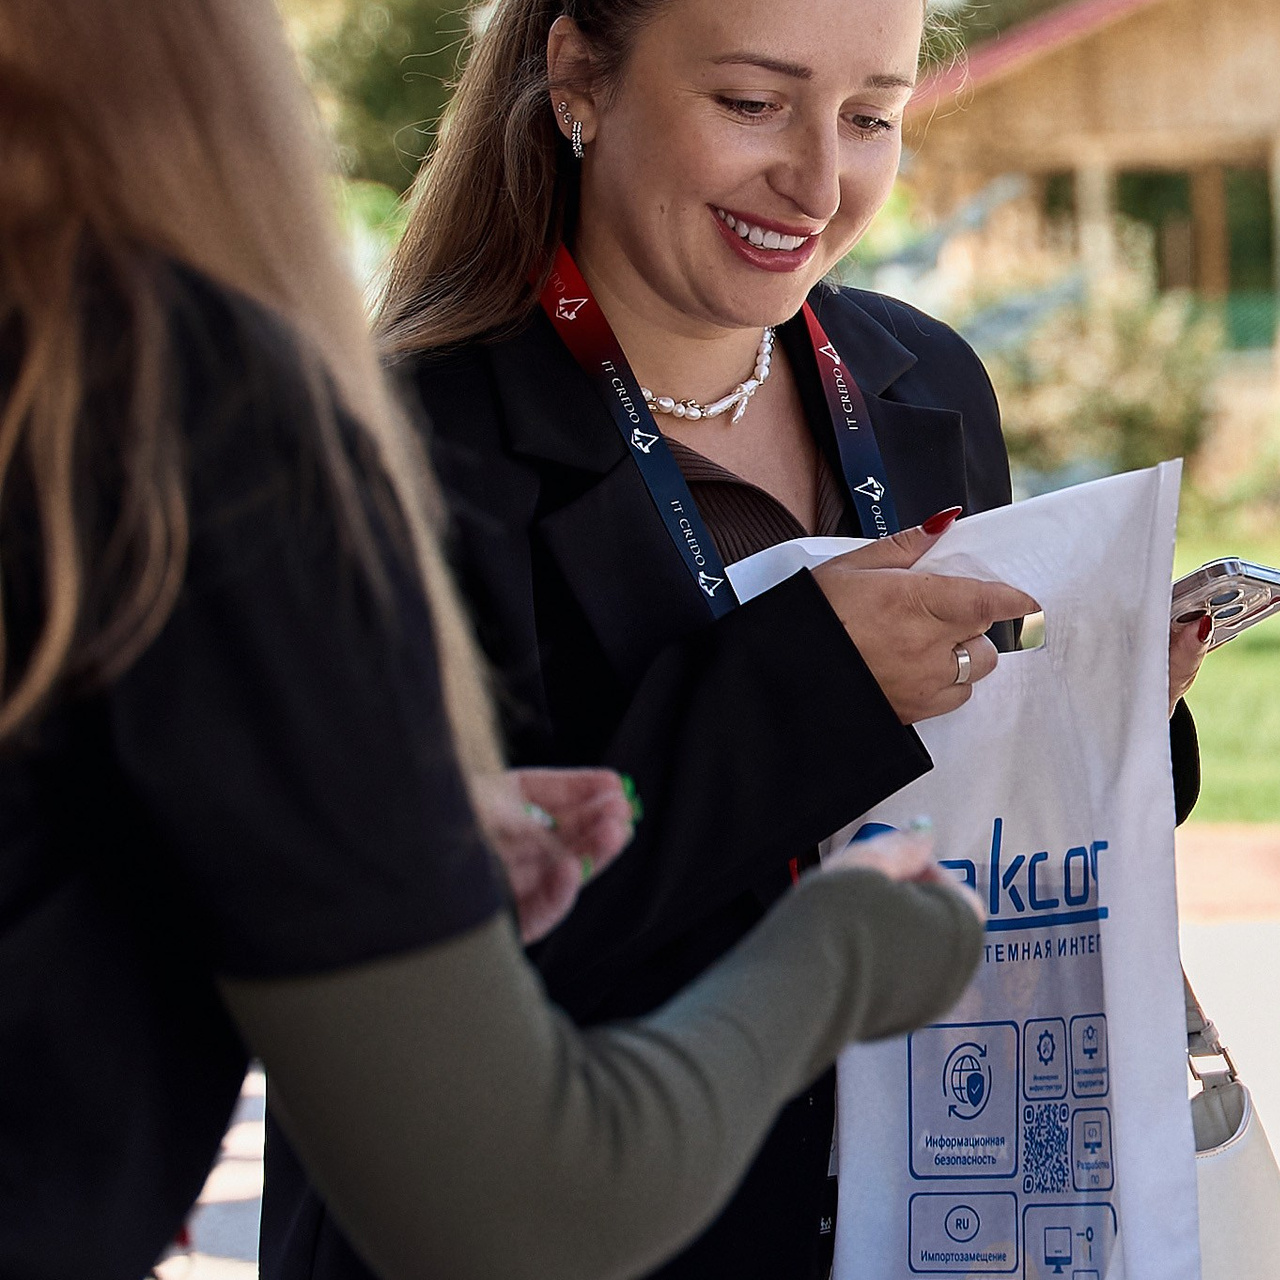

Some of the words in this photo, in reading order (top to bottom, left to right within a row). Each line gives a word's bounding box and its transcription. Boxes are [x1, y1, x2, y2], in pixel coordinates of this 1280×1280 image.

[601, 360, 616, 374] IT
[611, 377, 640, 424] CREDO
[832, 367, 854, 413] CREDO
[845, 417, 859, 430] IT
[670, 499, 684, 513] IT
[679, 517, 706, 566] CREDO
[870, 505, 888, 540] REDO
[984, 938, 1052, 963] ТЕМНАЯ
[925, 1134, 1005, 1150] Информационная
[934, 1153, 997, 1166] безопасность
[955, 1218, 970, 1230] RU
[920, 1250, 1007, 1264] Импортозамещение
